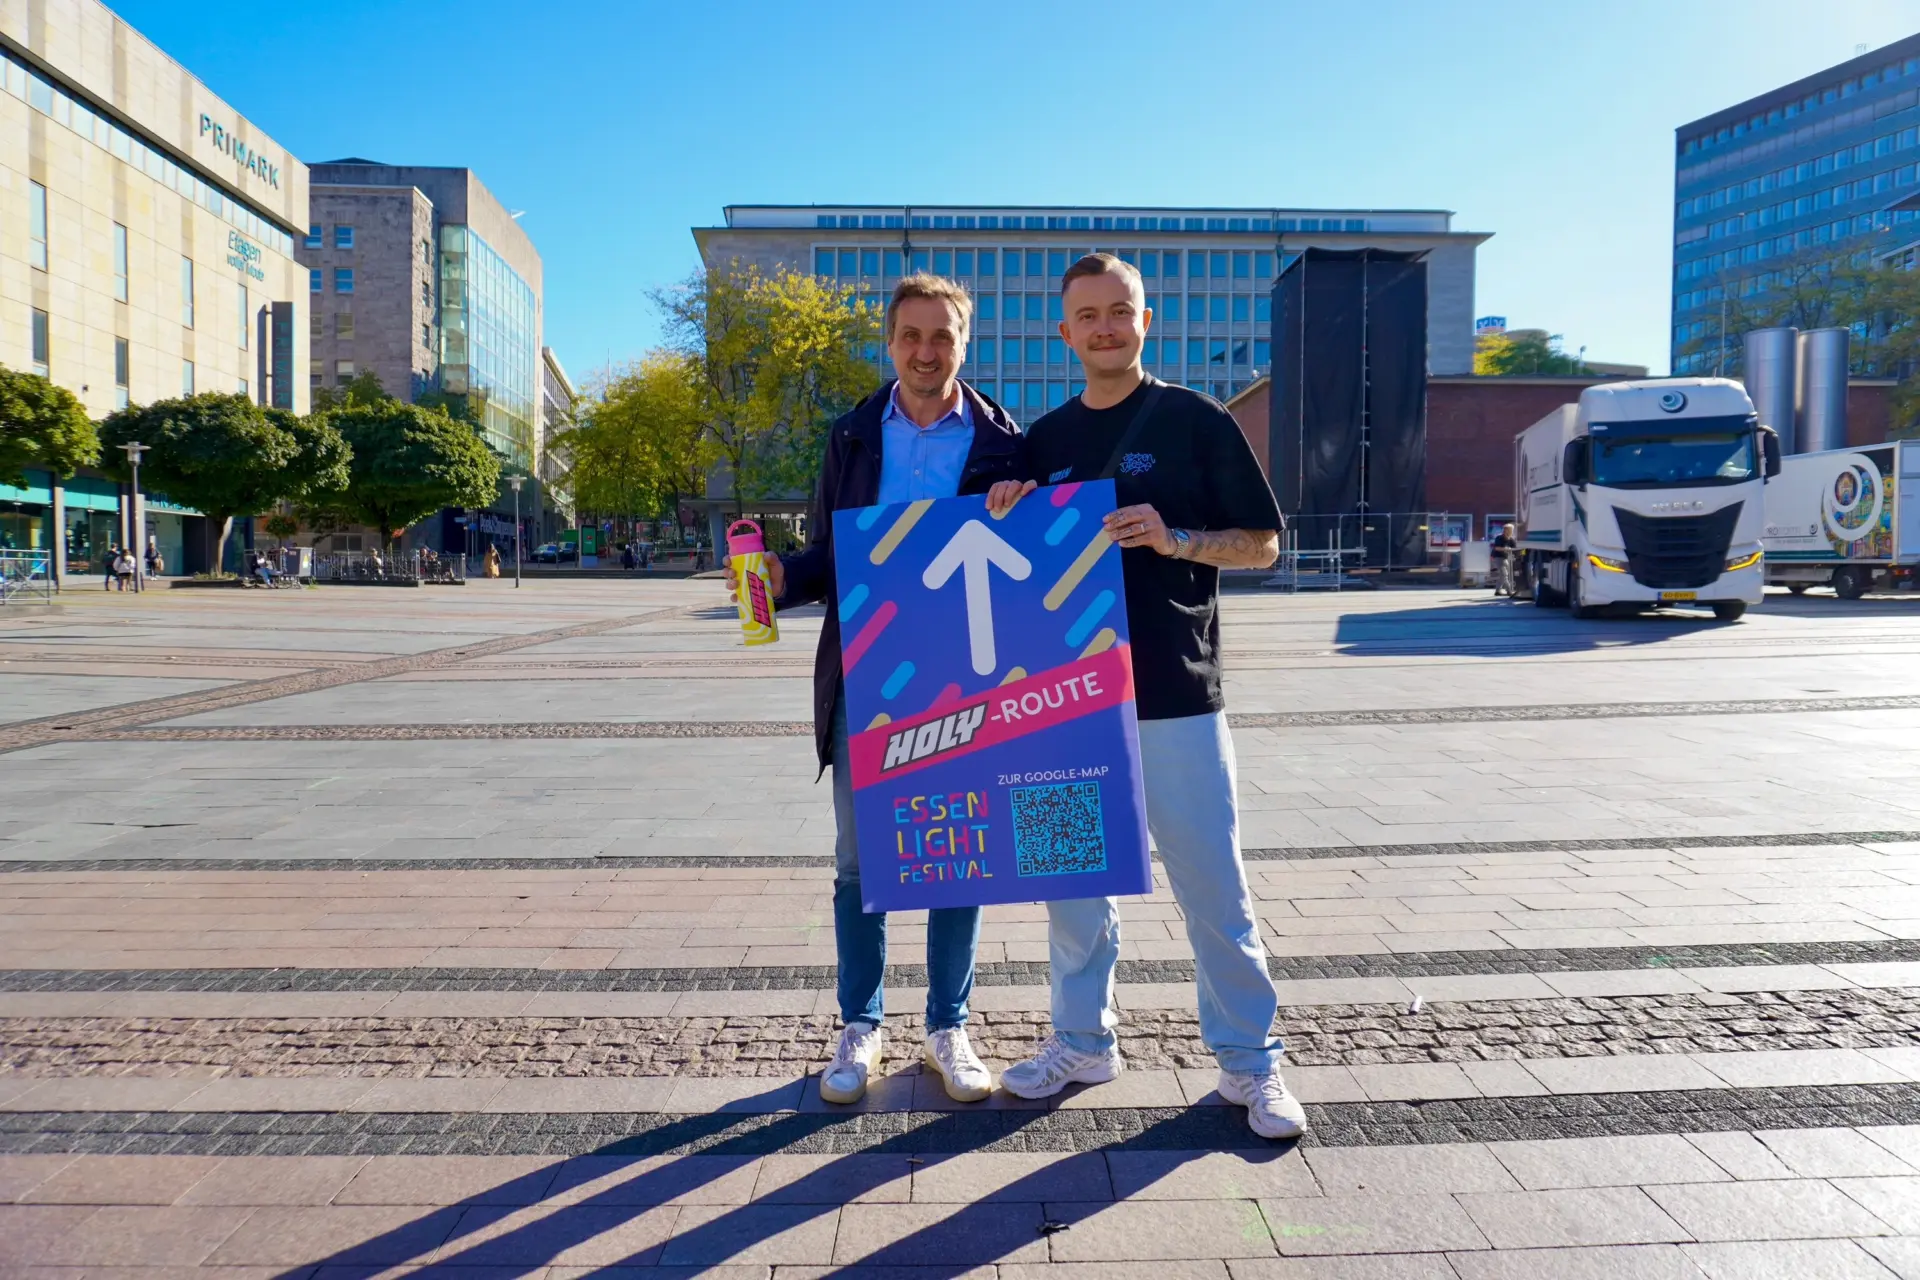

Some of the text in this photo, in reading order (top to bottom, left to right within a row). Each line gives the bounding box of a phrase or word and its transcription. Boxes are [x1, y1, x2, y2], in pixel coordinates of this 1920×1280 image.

[199, 113, 279, 190] PRIMARK
[228, 230, 261, 264] Etagen
[275, 320, 290, 404] PRIMAR
[998, 766, 1109, 785] ZUR GOOGLE-MAP
[894, 791, 989, 823] ESSEN
[897, 824, 989, 858] LIGHT
[900, 859, 993, 884] FESTIVAL
